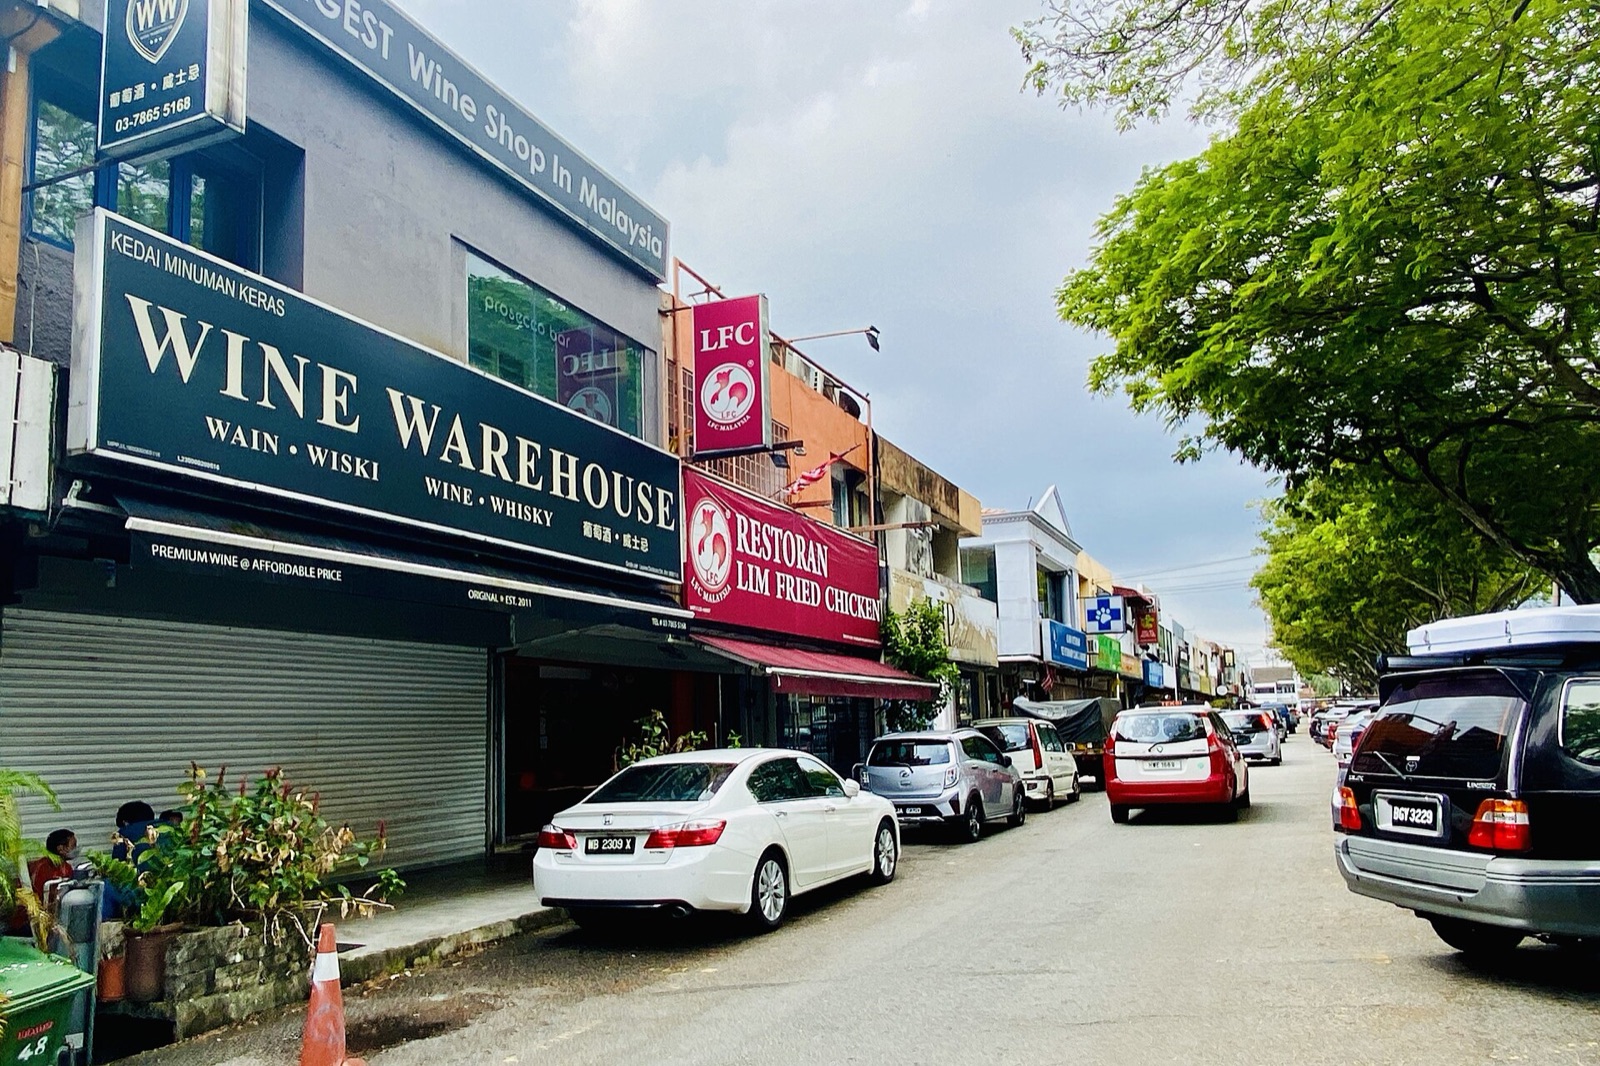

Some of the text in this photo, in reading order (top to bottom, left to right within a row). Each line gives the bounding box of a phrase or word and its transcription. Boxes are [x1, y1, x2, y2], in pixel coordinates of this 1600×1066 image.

[110, 82, 145, 108] 葡萄酒
[115, 96, 191, 132] 03-7865 5168
[408, 42, 477, 123] Wine
[484, 104, 546, 175] Shop
[552, 154, 572, 194] In
[579, 176, 662, 259] Malaysia
[111, 230, 285, 317] KEDAI MINUMAN KERAS
[485, 296, 571, 349] prosecco bar
[700, 321, 755, 352] LFC
[124, 293, 676, 532] WINE WAREHOUSE
[707, 415, 751, 431] LFC MALAYSIA
[205, 415, 279, 456] WAIN
[306, 443, 379, 482] WISKI
[425, 476, 554, 528] WINE WHISKY
[583, 521, 612, 544] 葡萄酒
[736, 513, 829, 578] RESTORAN
[151, 544, 342, 581] PREMIUM WINE @ AFFORDABLE PRICE
[468, 589, 499, 603] ORIGINAL
[518, 597, 532, 607] 2011
[736, 560, 883, 622] LIM FRIED CHICKEN
[602, 839, 623, 850] 2309
[625, 838, 632, 850] X
[18, 1036, 48, 1060] 48
